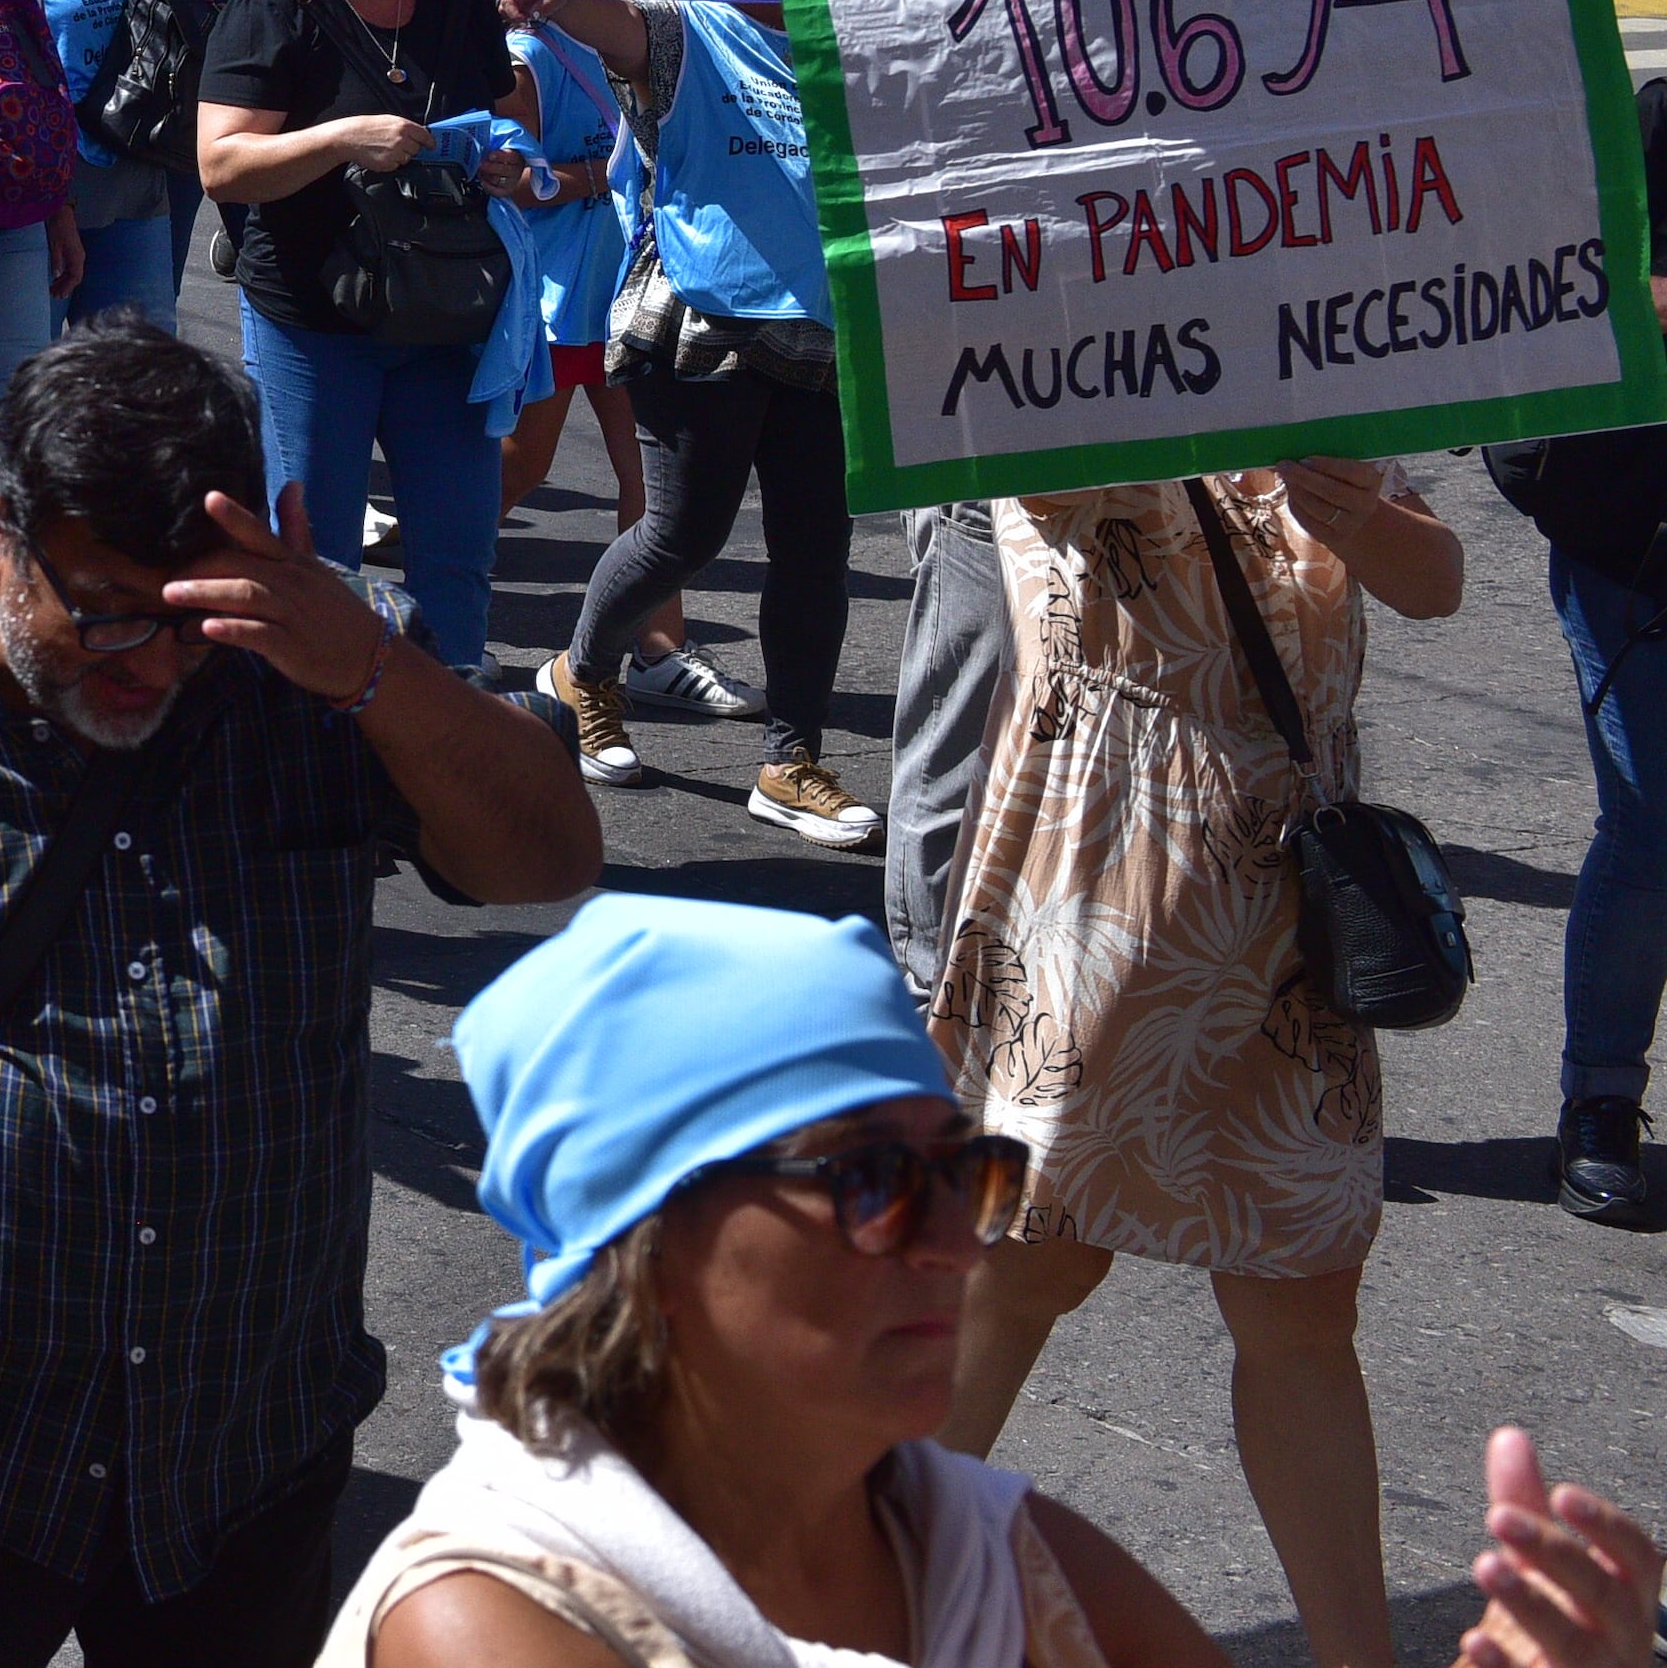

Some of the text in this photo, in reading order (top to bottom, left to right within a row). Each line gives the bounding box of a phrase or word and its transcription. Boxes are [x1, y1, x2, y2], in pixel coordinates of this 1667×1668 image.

[721, 92, 737, 104] de
[745, 106, 763, 118] de
[728, 135, 810, 159] Delegac
[940, 315, 1224, 418] MUCHAS
